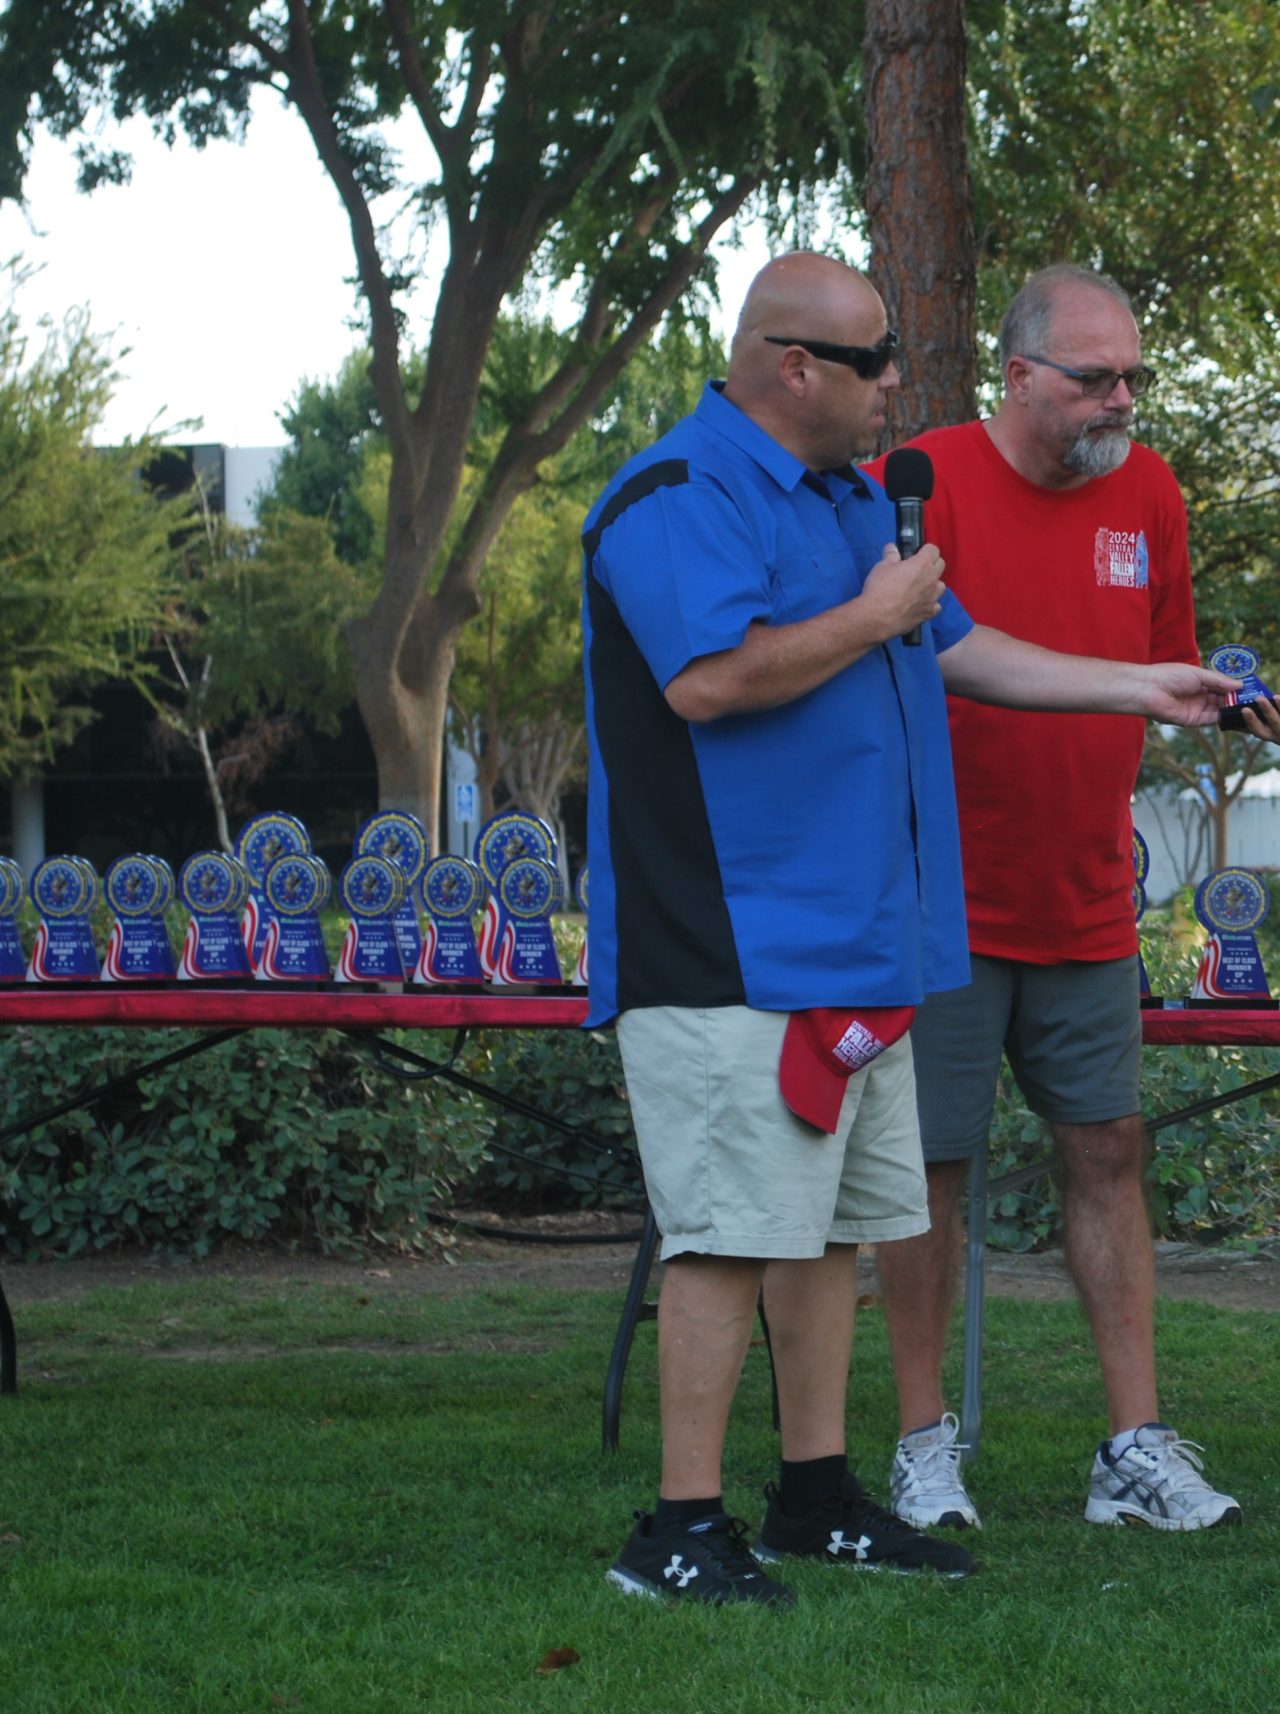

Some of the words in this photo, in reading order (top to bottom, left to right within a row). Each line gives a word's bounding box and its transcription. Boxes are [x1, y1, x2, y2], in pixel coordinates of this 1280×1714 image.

[1108, 531, 1135, 545] 2024
[1110, 552, 1135, 563] VALLEY
[1110, 562, 1134, 576] FALLEN
[1110, 575, 1136, 587] HEROES
[844, 1026, 880, 1058] FALLE
